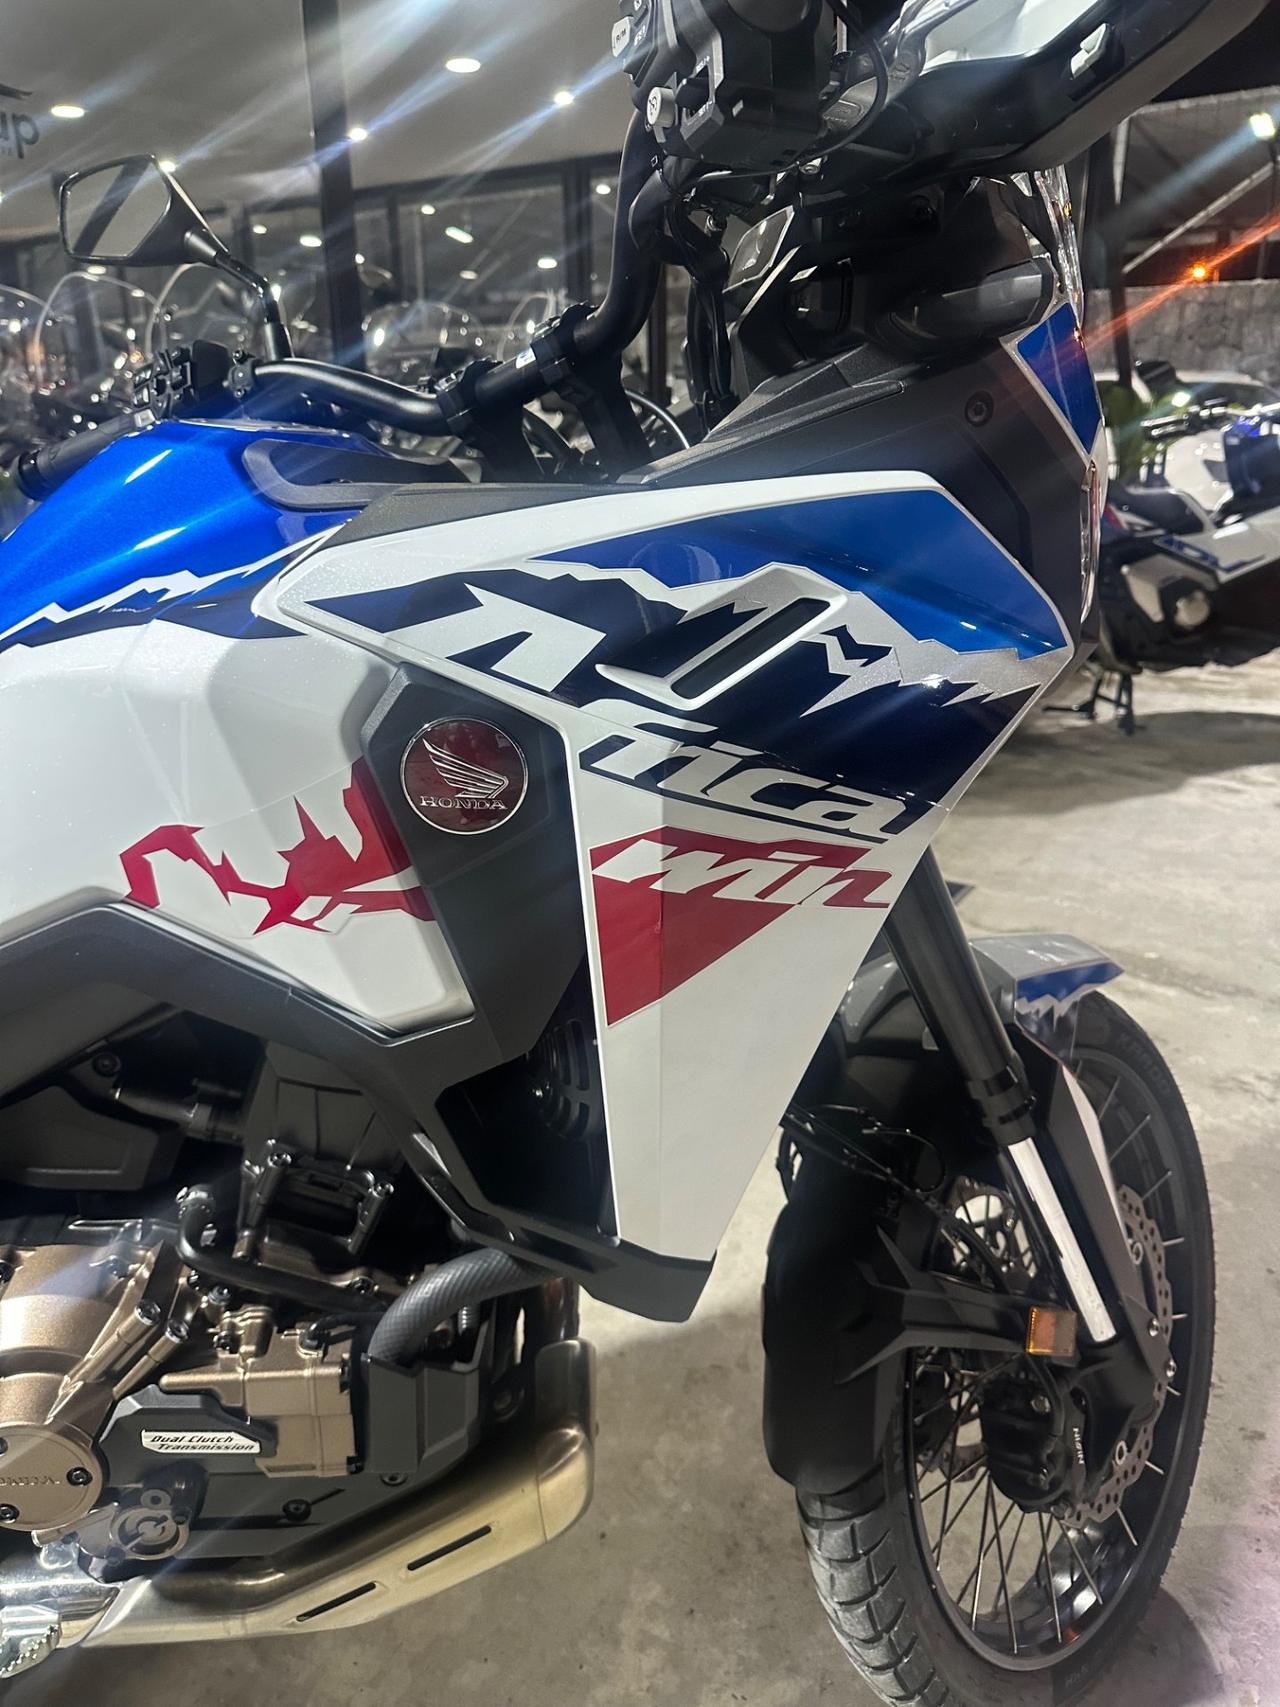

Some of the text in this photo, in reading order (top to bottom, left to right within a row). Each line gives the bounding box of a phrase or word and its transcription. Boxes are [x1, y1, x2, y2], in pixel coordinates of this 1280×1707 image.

[420, 795, 508, 810] HONDA
[150, 1435, 234, 1443] Dual Clutch
